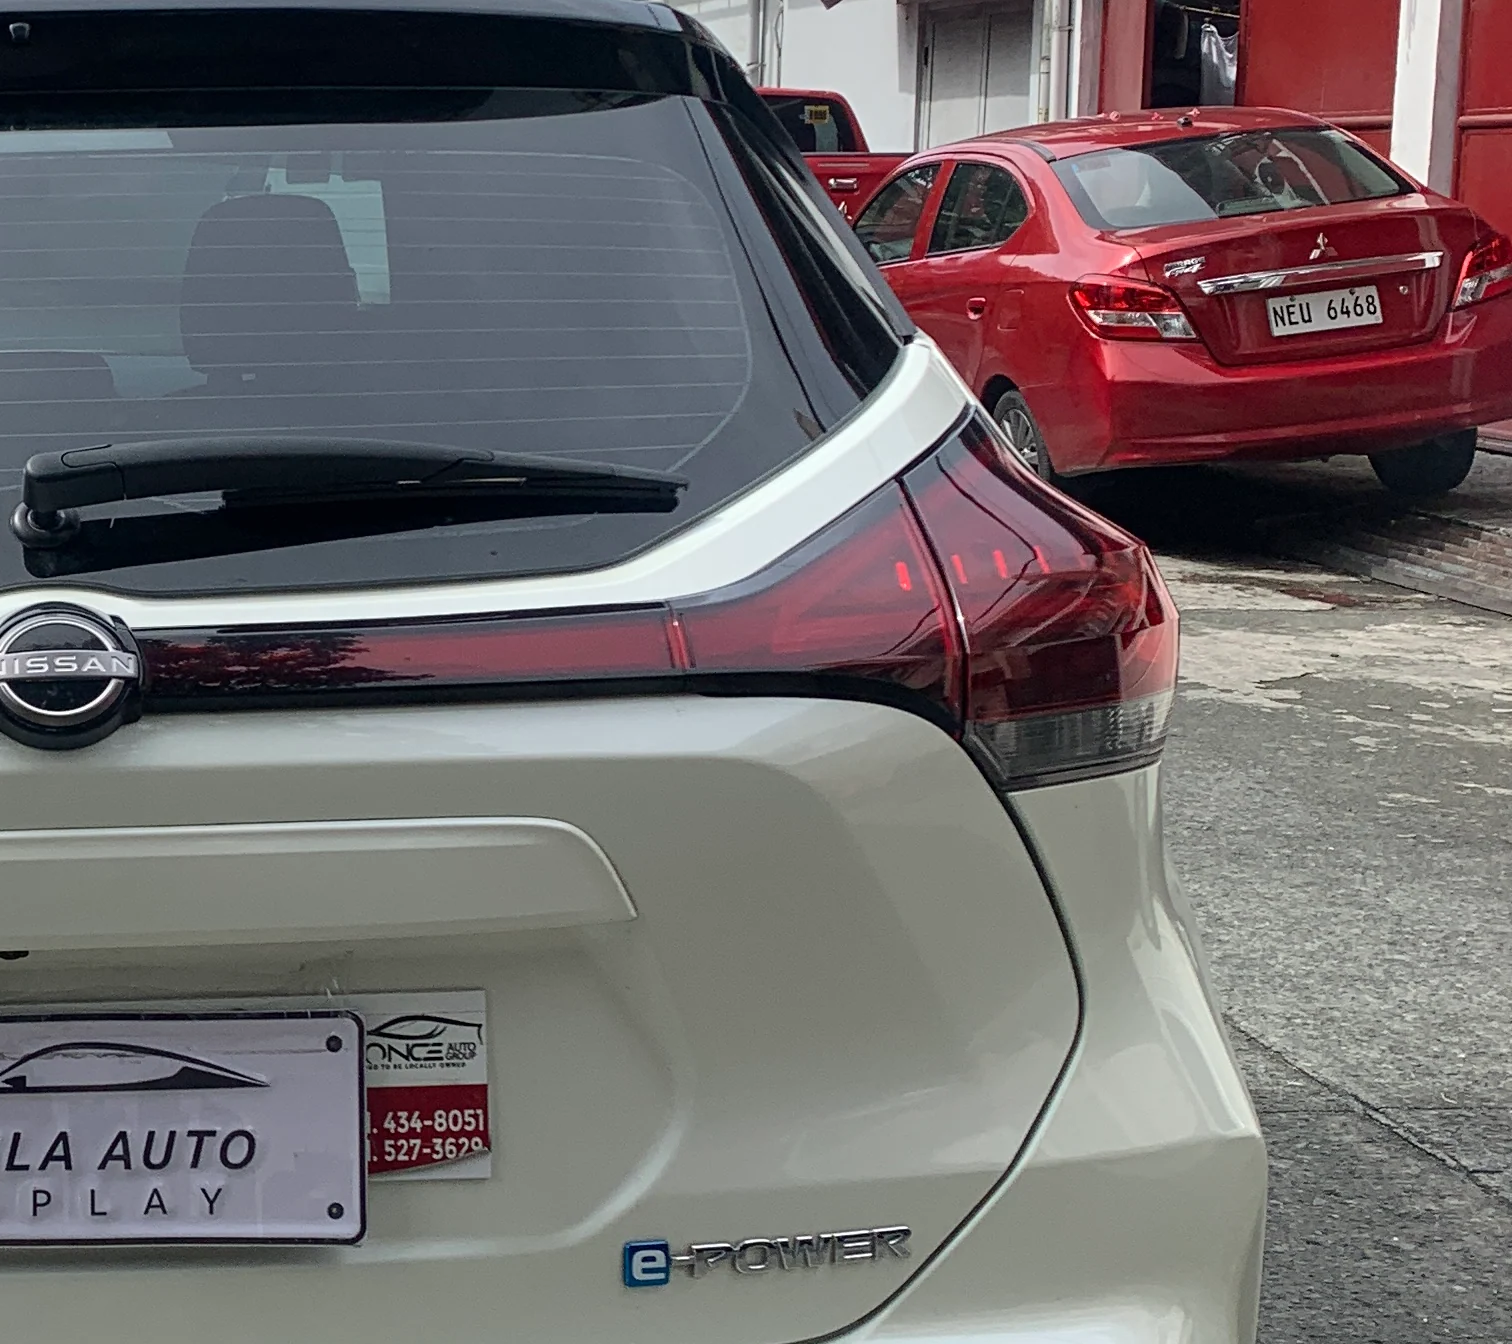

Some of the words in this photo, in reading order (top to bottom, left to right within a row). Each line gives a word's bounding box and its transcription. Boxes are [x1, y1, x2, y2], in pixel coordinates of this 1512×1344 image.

[1272, 302, 1312, 327] NEU
[1327, 295, 1377, 320] 6468
[383, 1109, 485, 1134] 434-8051
[97, 1130, 257, 1171] AUTO
